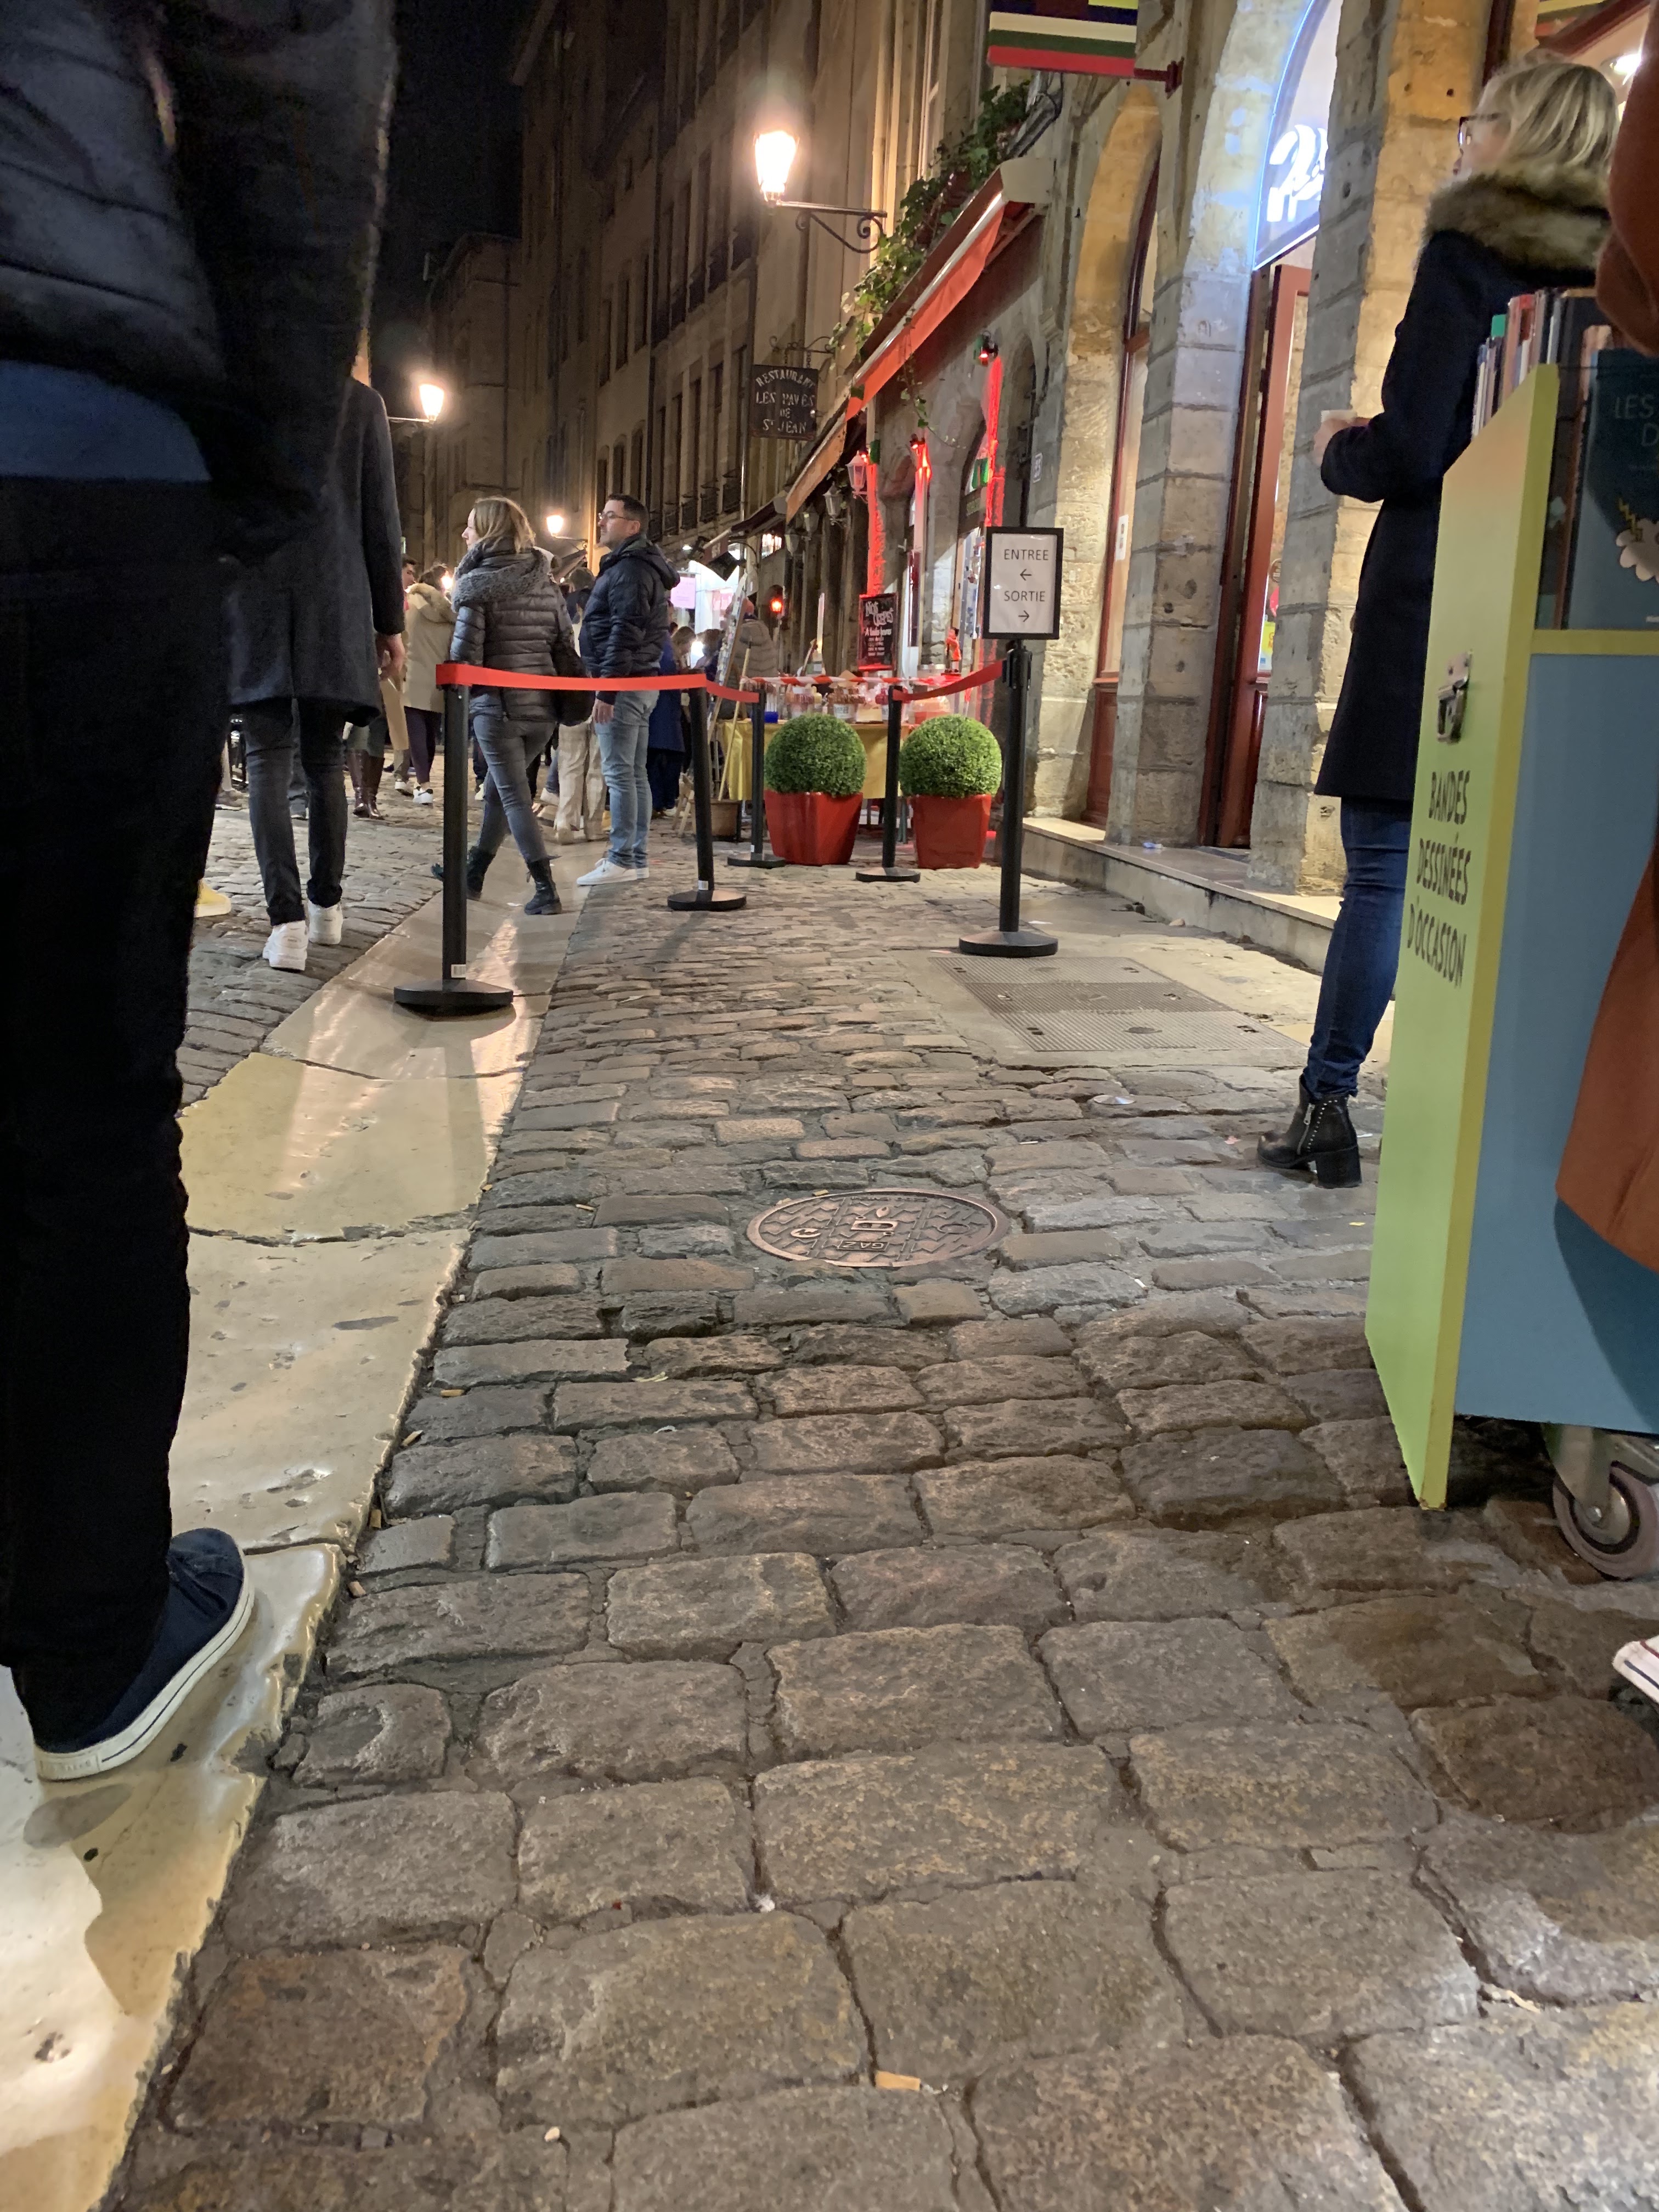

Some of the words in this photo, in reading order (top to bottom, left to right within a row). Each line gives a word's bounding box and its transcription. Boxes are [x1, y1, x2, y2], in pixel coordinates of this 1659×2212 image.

[756, 369, 816, 388] RESTAURANT
[756, 391, 777, 404] LES
[780, 408, 791, 419] DE
[777, 421, 806, 433] JEAN
[1004, 549, 1049, 560] ENTREE
[1004, 591, 1046, 601] SORTIE
[1429, 770, 1470, 825] BANDES
[1417, 832, 1471, 905] DESSINÉES
[1407, 895, 1467, 988] D'OCCASION
[843, 1241, 884, 1249] GAZ
